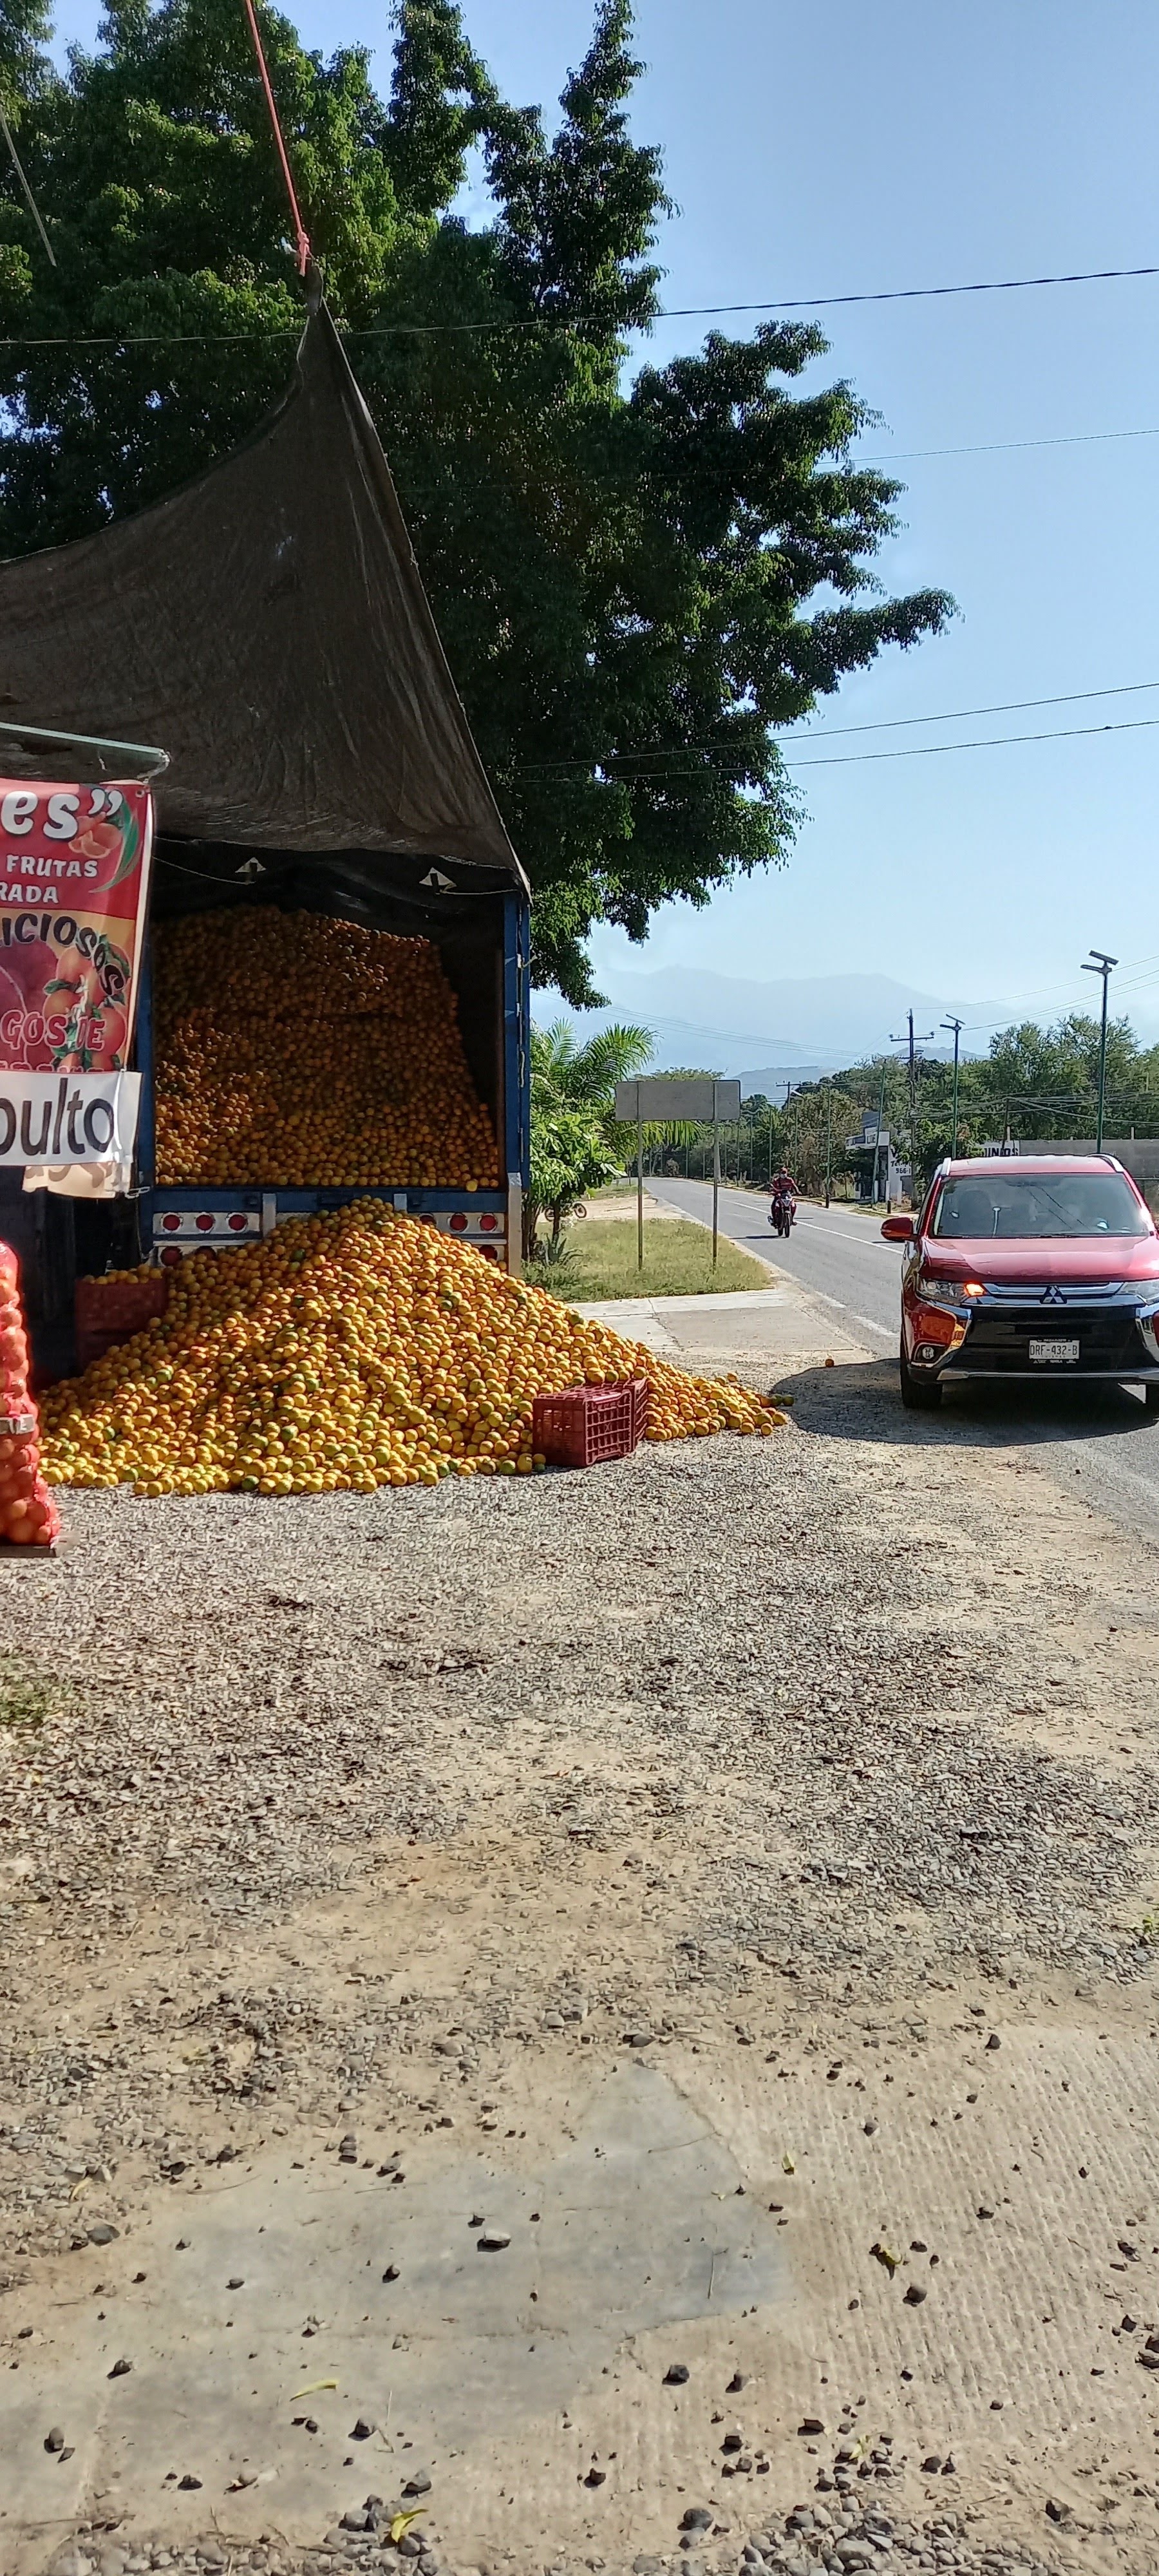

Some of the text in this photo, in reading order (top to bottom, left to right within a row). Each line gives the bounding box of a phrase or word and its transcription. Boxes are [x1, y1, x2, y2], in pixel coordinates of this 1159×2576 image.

[6, 854, 98, 878] FRUTAS
[0, 913, 124, 995] ICIOSOS
[1030, 1345, 1077, 1356] DRF-432-B
